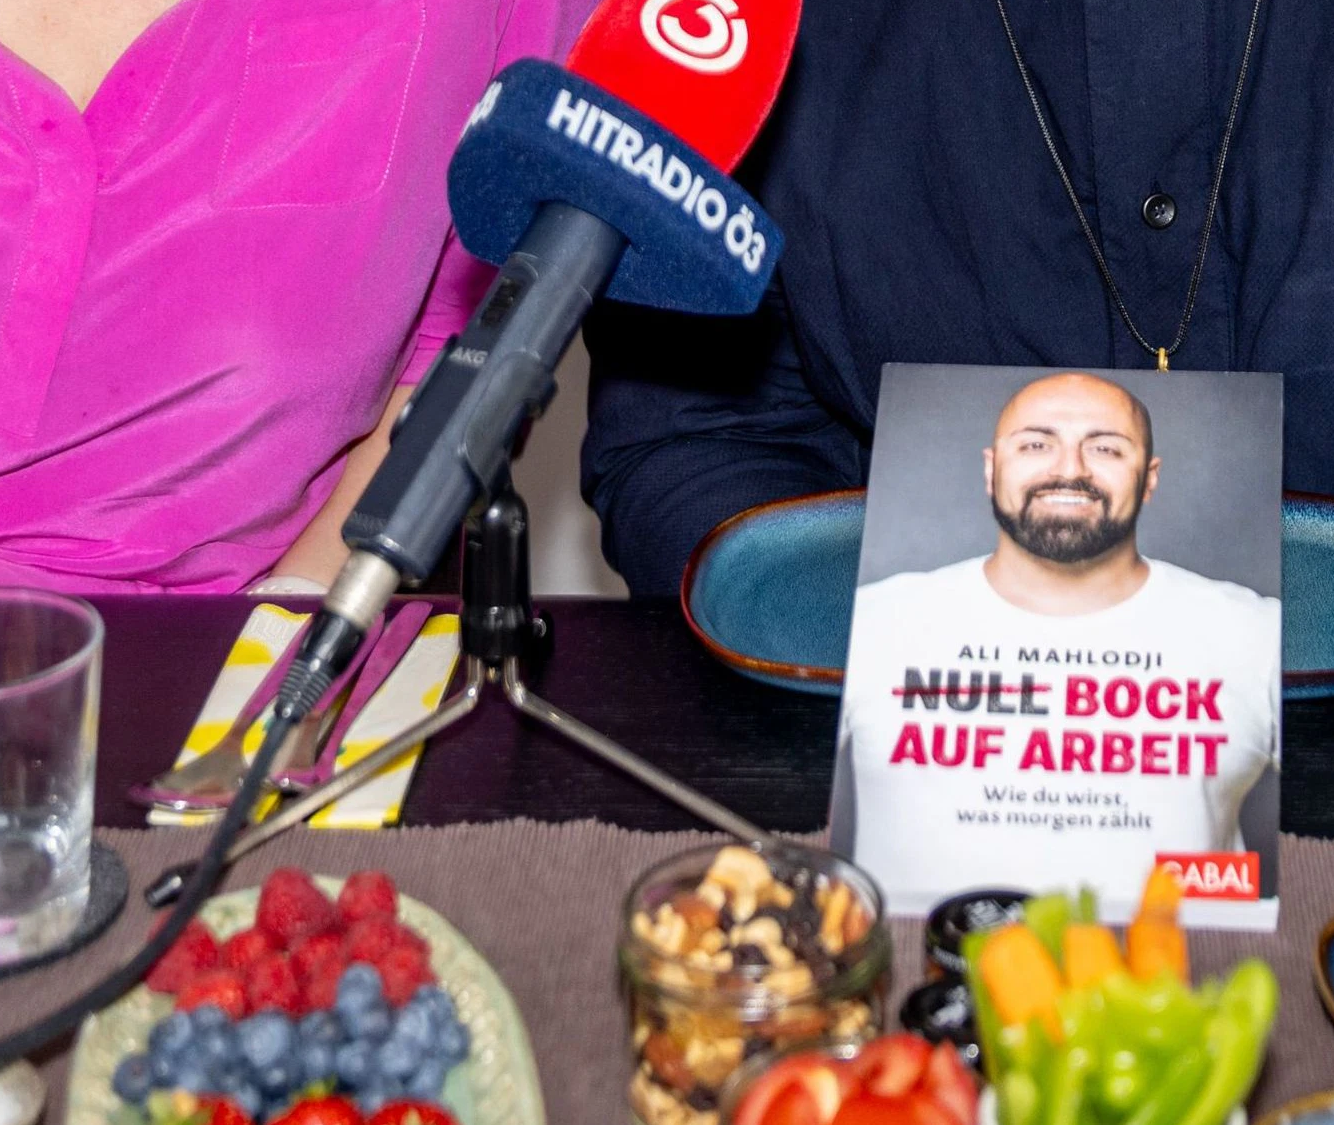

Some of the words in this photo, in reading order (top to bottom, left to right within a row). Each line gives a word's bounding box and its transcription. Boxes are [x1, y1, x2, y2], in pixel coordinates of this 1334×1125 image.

[546, 88, 727, 231] HITRADIO
[724, 204, 766, 273] Ö3
[449, 347, 489, 365] AKG
[958, 644, 1001, 661] ALI
[1017, 647, 1164, 671] MAHLODJI
[900, 666, 1050, 716] NULL
[1064, 673, 1225, 722] BOCK
[888, 721, 1006, 769] AUF
[1017, 727, 1229, 778] ARBEIT
[983, 784, 1027, 803] Wie
[1033, 785, 1060, 804] du
[1066, 788, 1129, 809] wirst,
[957, 808, 1001, 824] was
[1006, 810, 1092, 831] morgen
[1098, 809, 1153, 830] zählt
